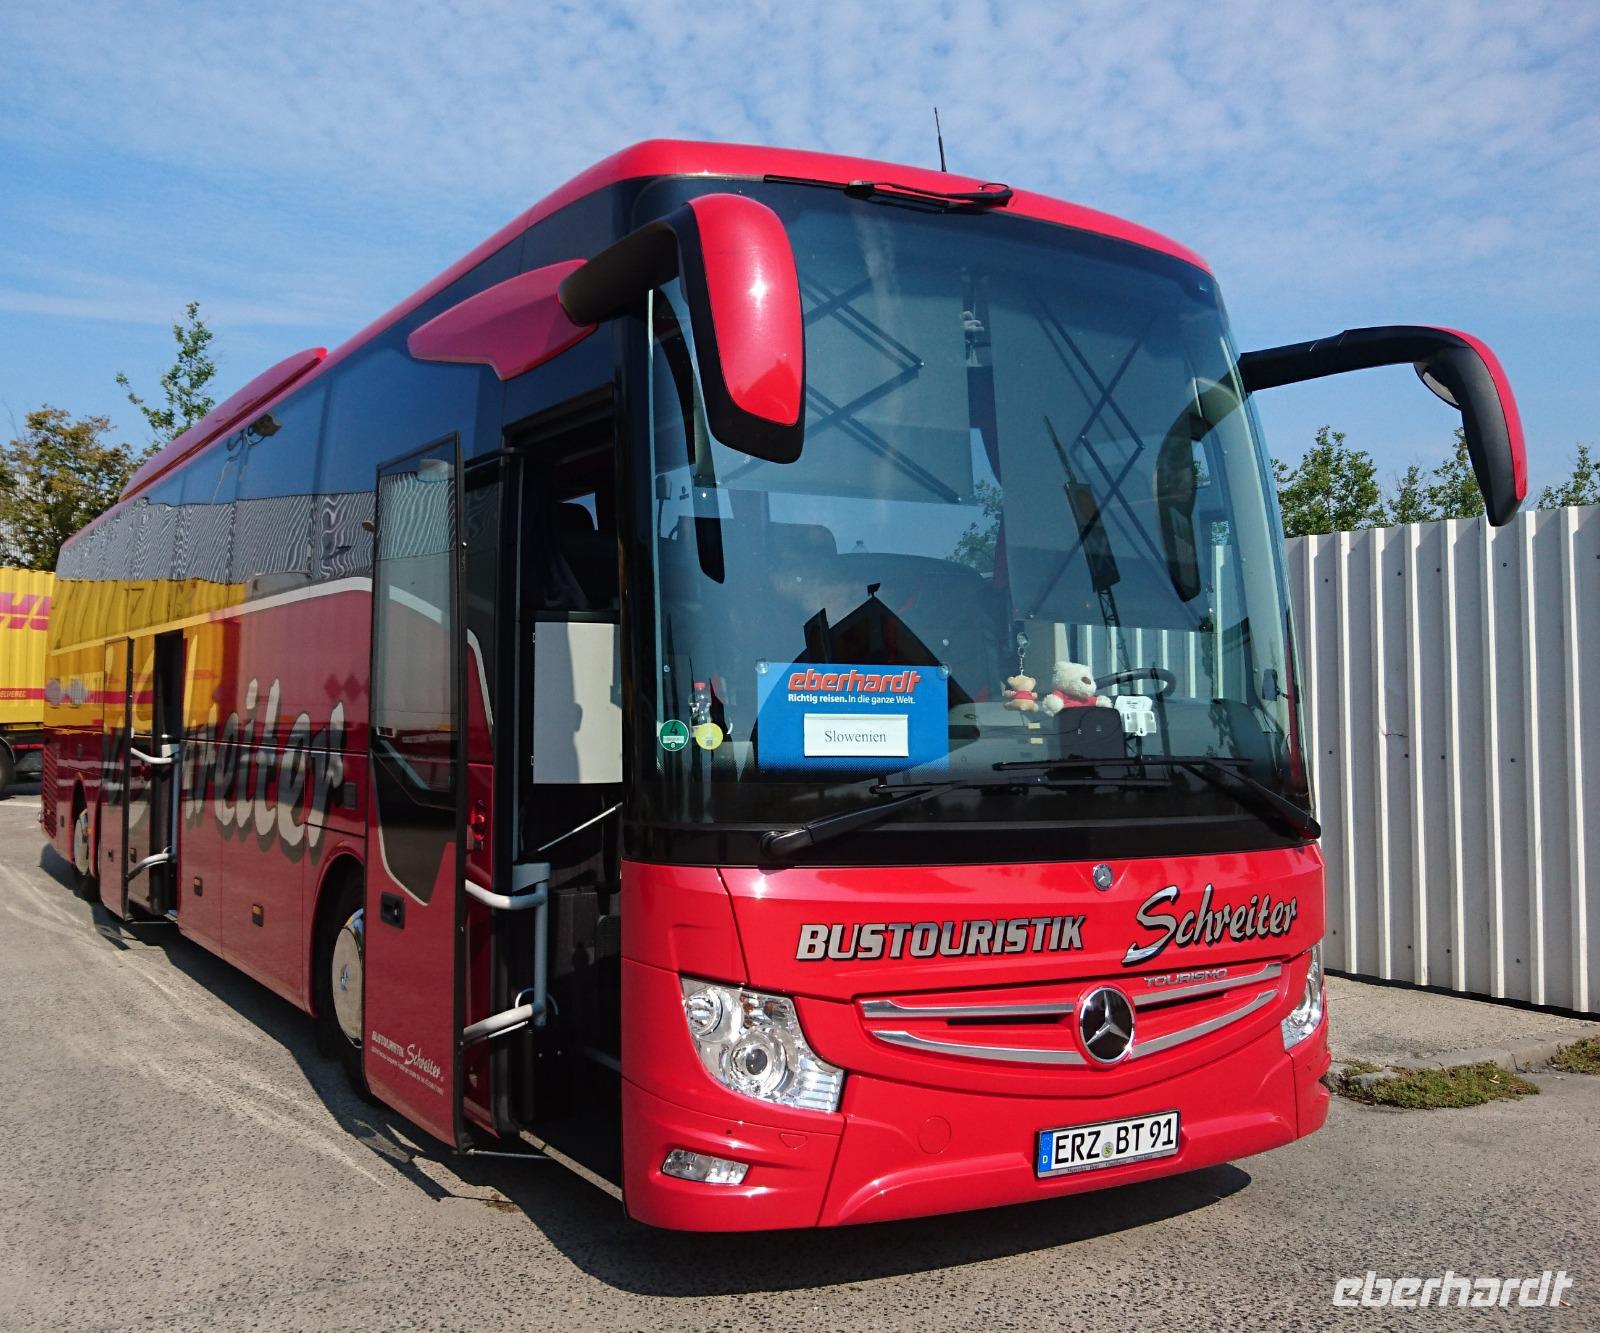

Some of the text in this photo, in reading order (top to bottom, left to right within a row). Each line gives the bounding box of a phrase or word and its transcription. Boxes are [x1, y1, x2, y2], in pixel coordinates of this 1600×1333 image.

[788, 668, 921, 693] eberhardt
[788, 693, 916, 705] Richtig reisen. In die ganze Welt.
[824, 730, 887, 743] Slowenien
[795, 883, 1298, 966] BUSTOURISTIK Schreiter
[1143, 968, 1228, 988] TOURISMO
[1054, 1130, 1102, 1164] ERZ
[1116, 1122, 1145, 1155] BT
[1149, 1118, 1174, 1149] 91
